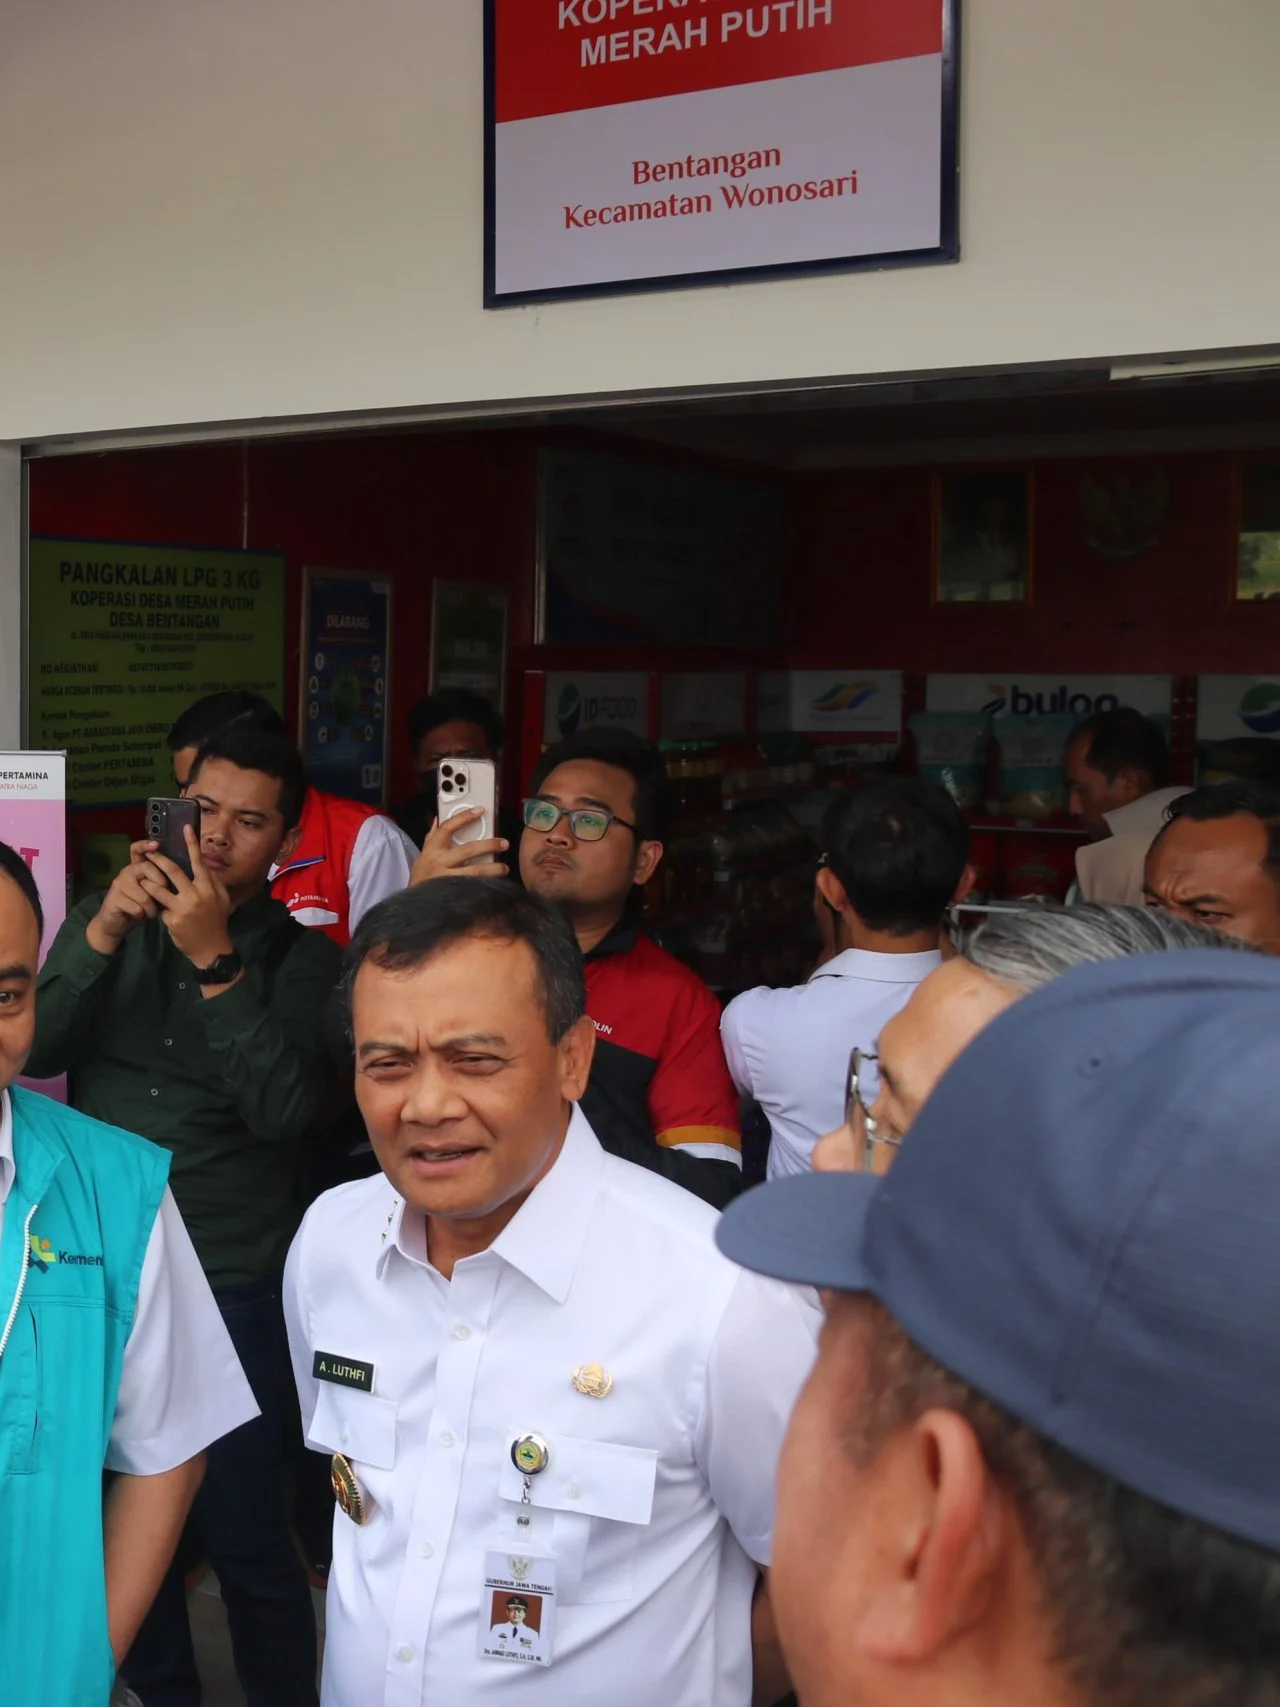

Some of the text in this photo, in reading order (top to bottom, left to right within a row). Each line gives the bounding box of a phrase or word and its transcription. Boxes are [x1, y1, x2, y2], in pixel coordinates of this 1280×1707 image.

[580, 0, 832, 67] MERAH PUTIH
[632, 147, 781, 185] Bentangan
[563, 170, 858, 229] Kecamatan Wonosari
[59, 561, 261, 590] PANGKALAN LPG 3 KG
[70, 590, 254, 611] KOPERASI DESA MERAH PUTIH
[109, 611, 220, 630] DESA BENTANGAN
[326, 611, 370, 630] DILARANG
[58, 1250, 104, 1267] Kemen
[333, 1363, 365, 1382] LUTHFI
